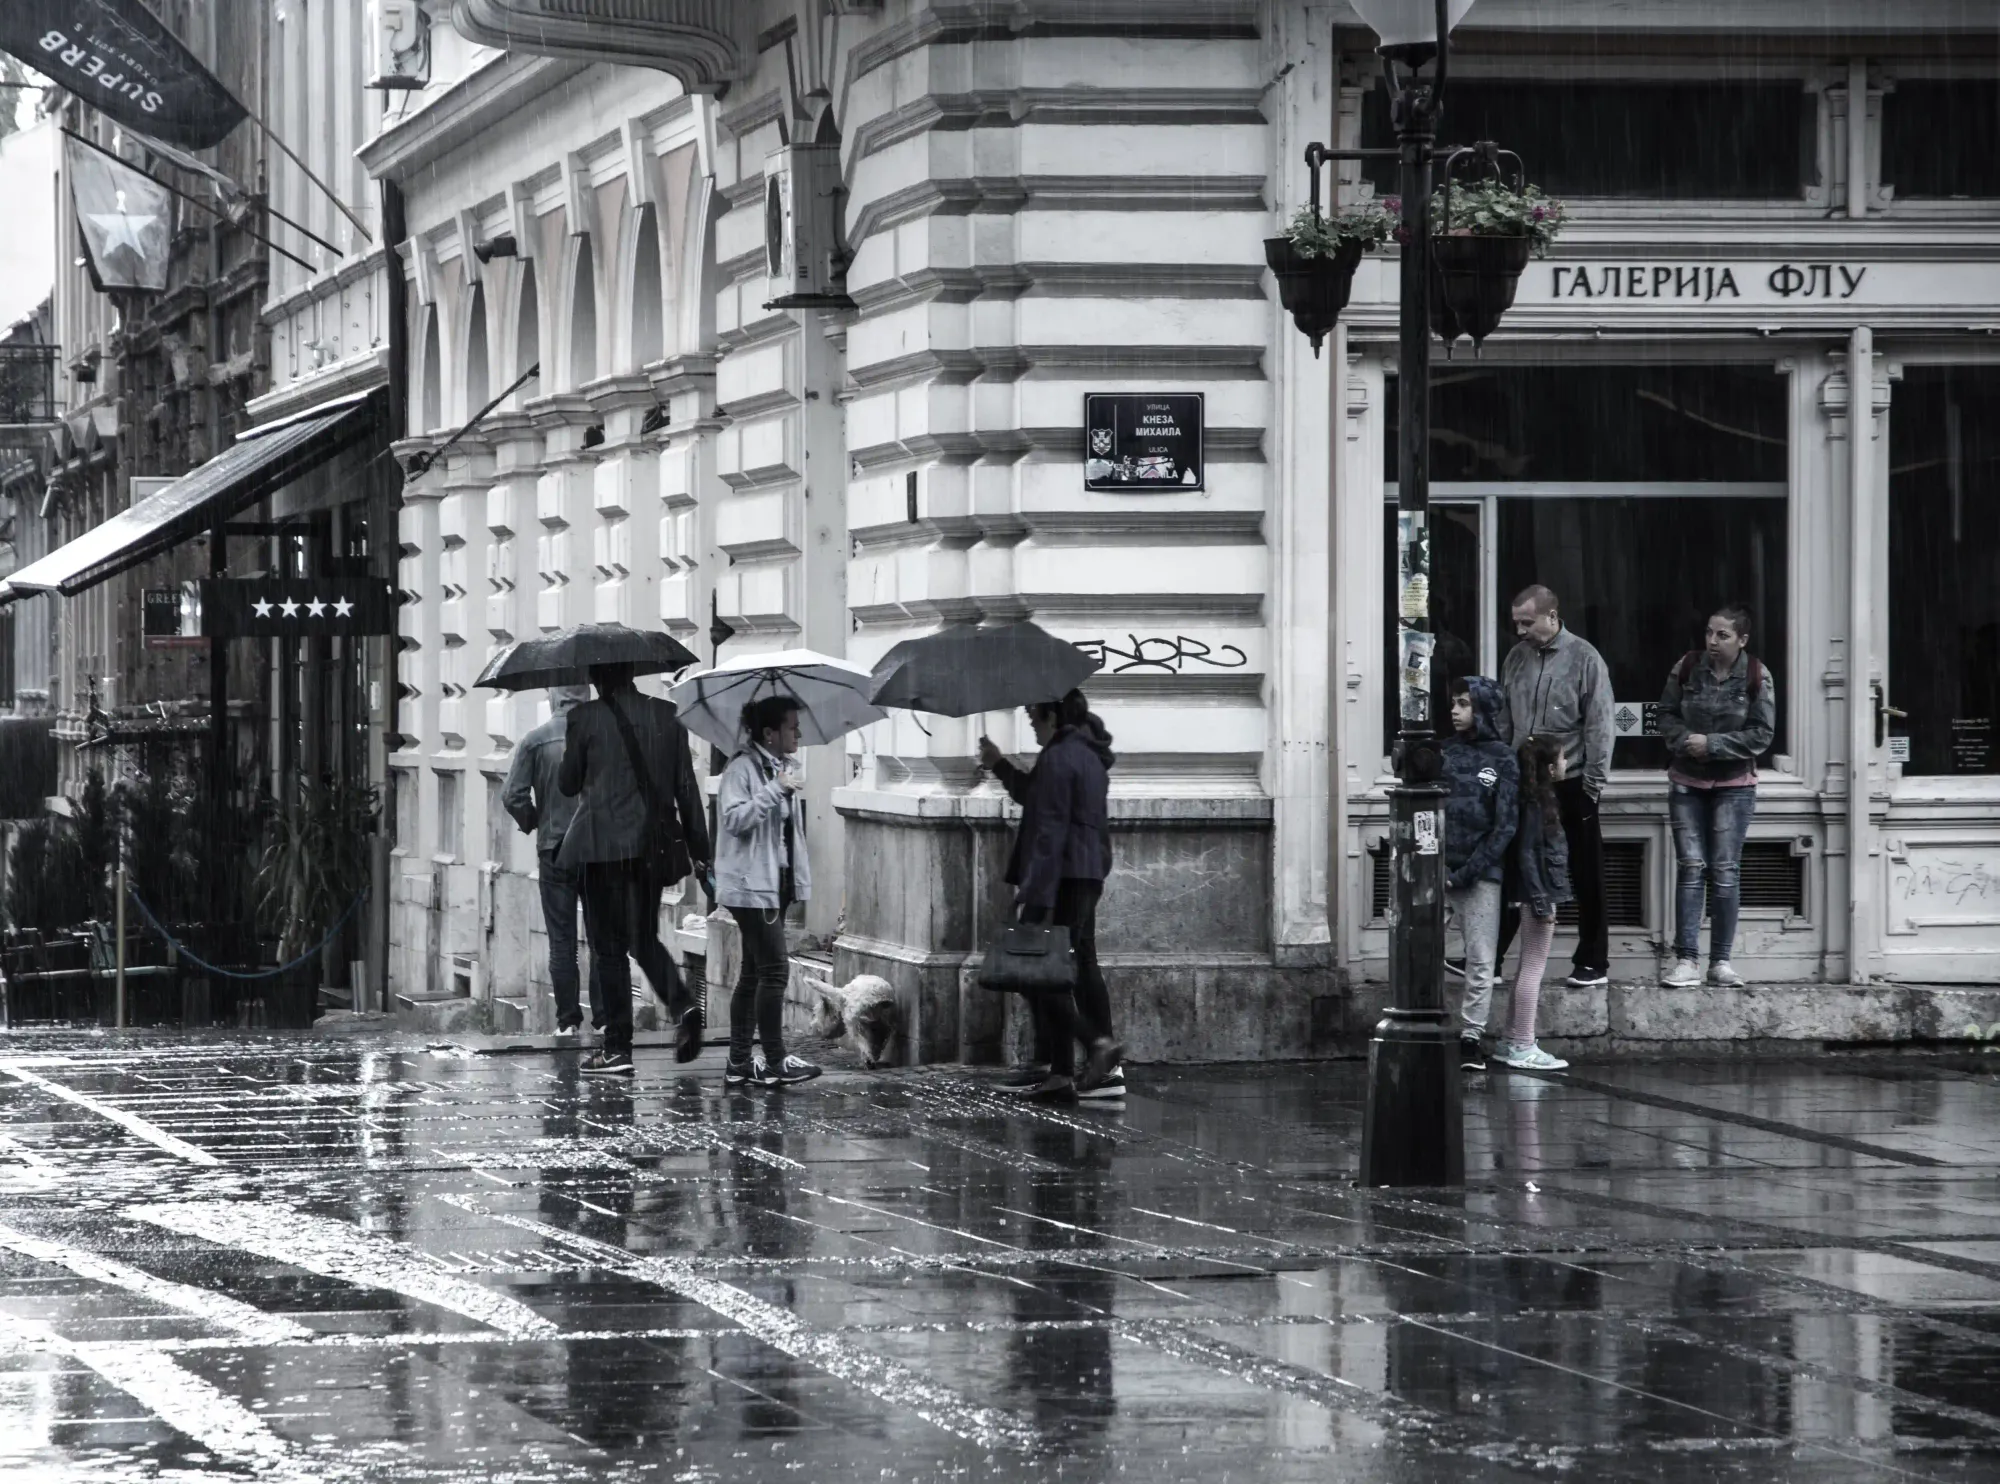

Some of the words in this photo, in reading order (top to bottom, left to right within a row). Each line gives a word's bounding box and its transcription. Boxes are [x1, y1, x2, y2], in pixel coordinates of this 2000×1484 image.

[39, 30, 164, 113] SUPERB
[1552, 266, 1740, 301] ГАЛЕРИЈА
[1768, 264, 1867, 299] ФЛУ
[1143, 415, 1174, 424] КНЕЗА
[1136, 427, 1181, 436] МИХАИЛА
